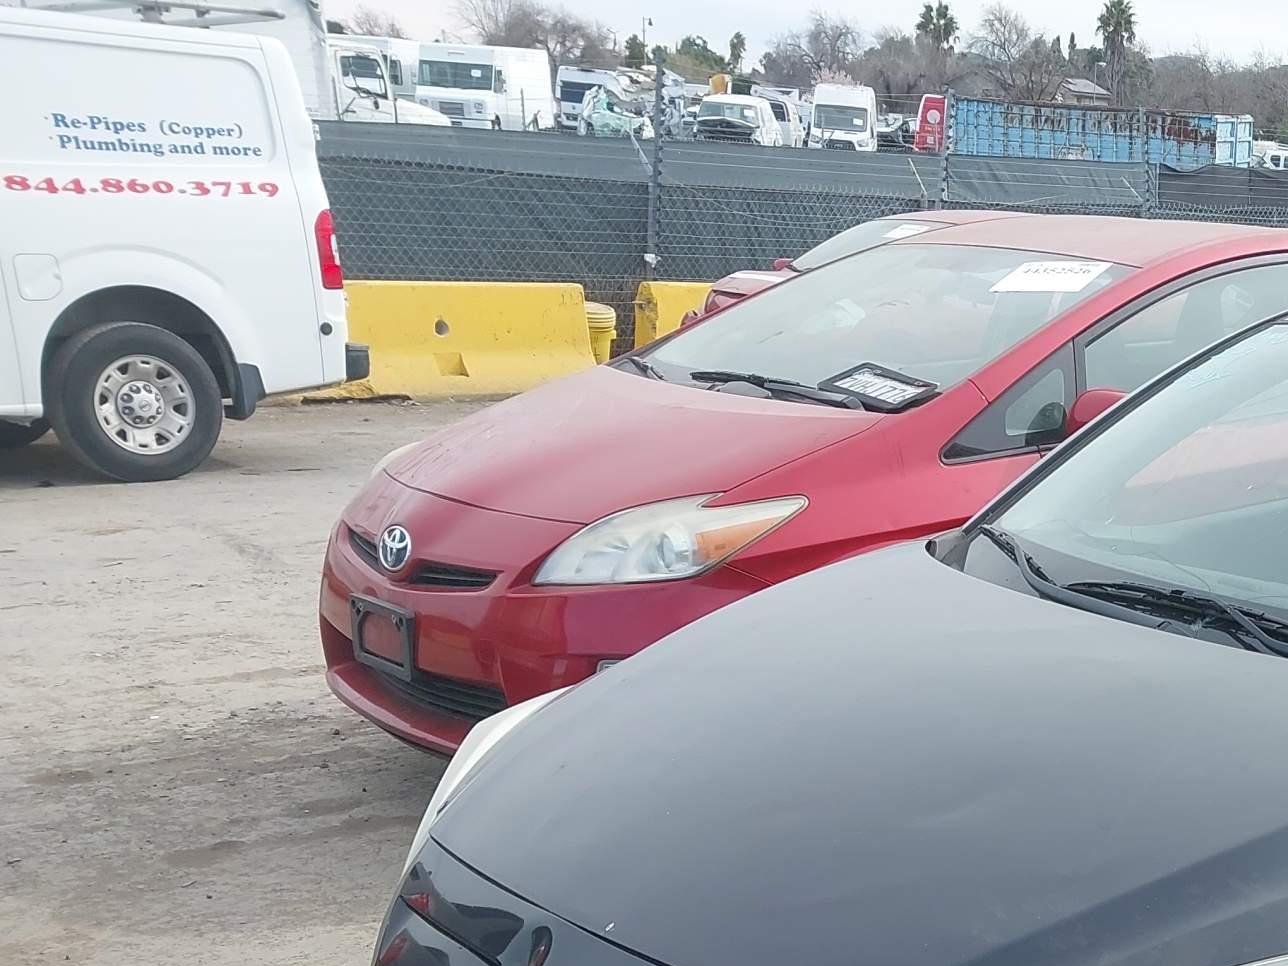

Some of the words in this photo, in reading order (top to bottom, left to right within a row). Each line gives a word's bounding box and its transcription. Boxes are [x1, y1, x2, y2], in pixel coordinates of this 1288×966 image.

[51, 112, 147, 135] Re-Pipes
[159, 119, 243, 139] (Copper)
[57, 133, 165, 157] Plumbing
[168, 142, 206, 156] and
[212, 145, 262, 157] more
[3, 174, 280, 198] 844.860.3719
